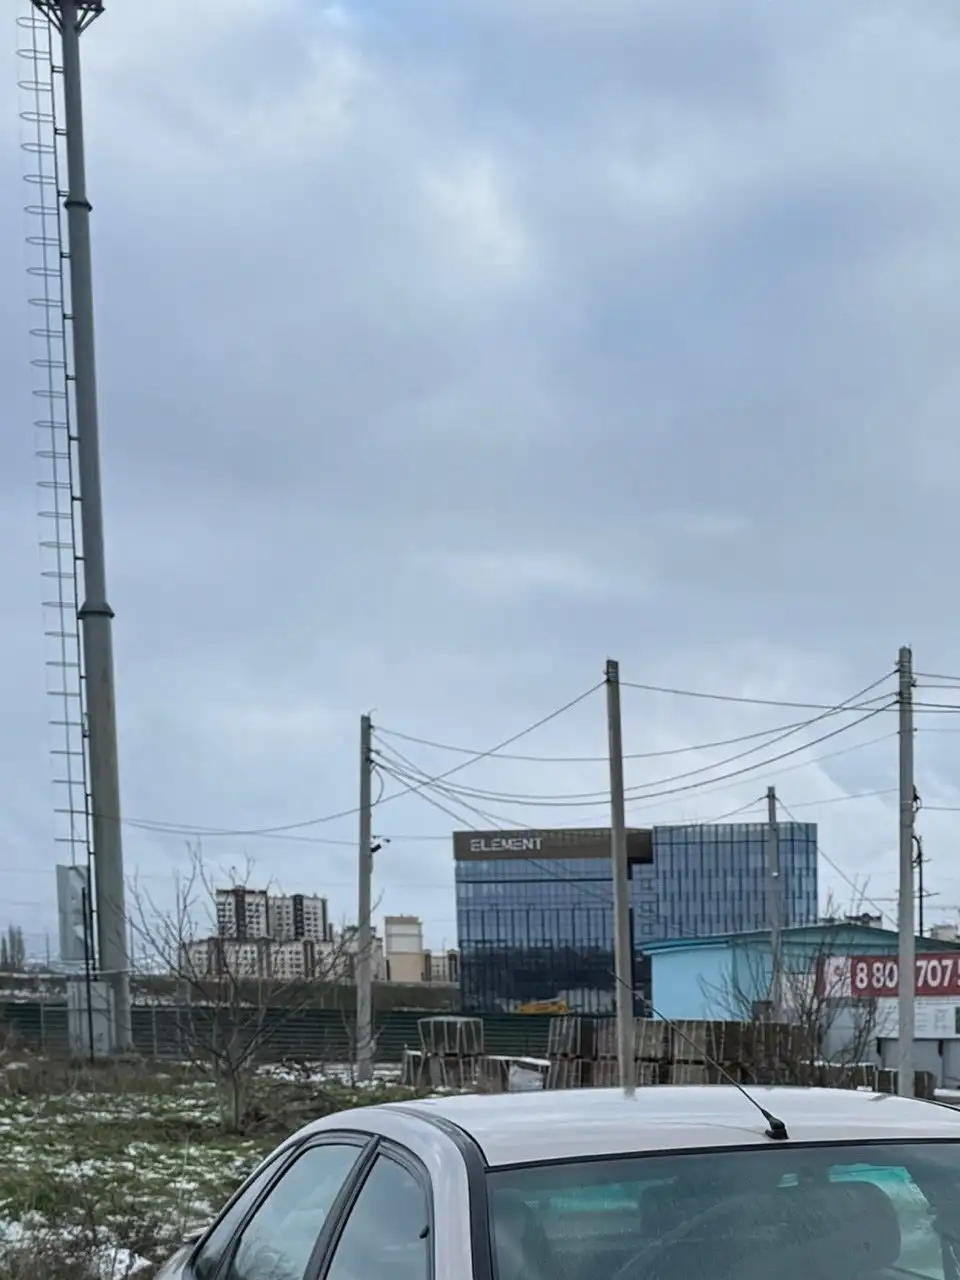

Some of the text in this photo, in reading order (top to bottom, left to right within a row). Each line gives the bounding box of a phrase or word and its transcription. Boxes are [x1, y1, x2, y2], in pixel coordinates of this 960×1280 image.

[470, 838, 542, 851] ELEMENT
[856, 962, 868, 988] 8
[916, 959, 953, 988] 707
